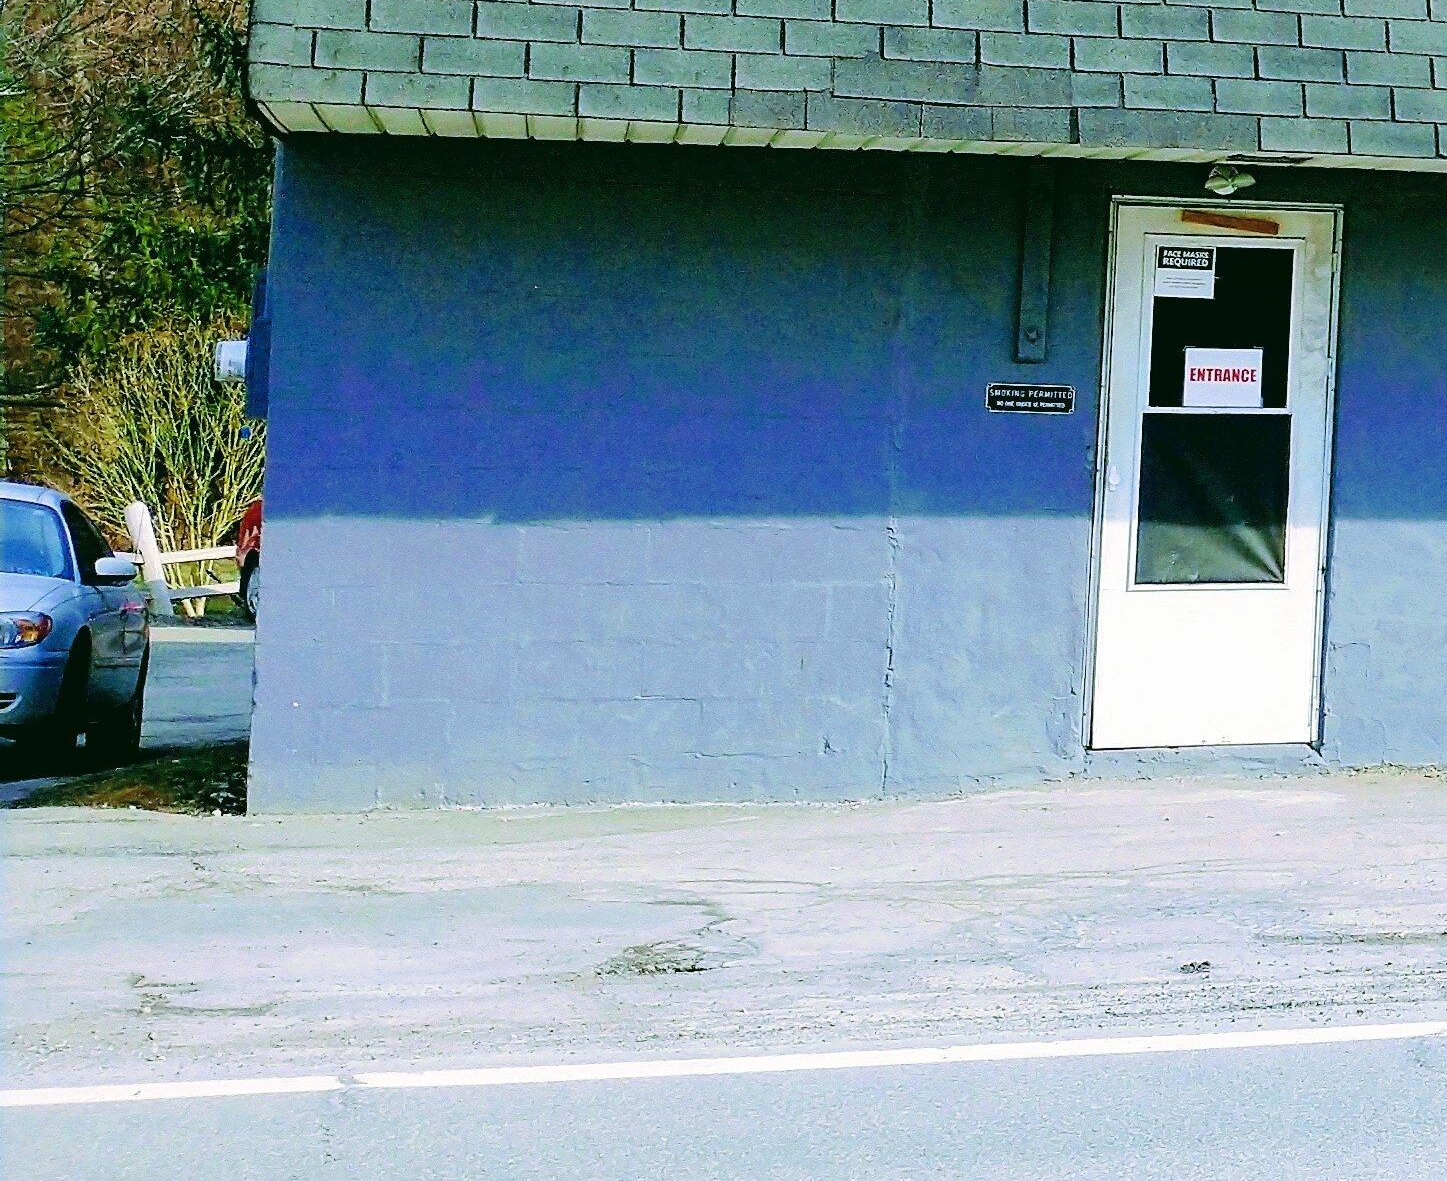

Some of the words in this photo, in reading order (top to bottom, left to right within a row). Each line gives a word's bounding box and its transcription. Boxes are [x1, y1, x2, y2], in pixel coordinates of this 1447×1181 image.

[1162, 257, 1209, 267] REQUIRED
[1189, 367, 1257, 383] ENTRANCE
[989, 389, 1025, 397] SMOKING
[1028, 390, 1073, 399] PERMITTED
